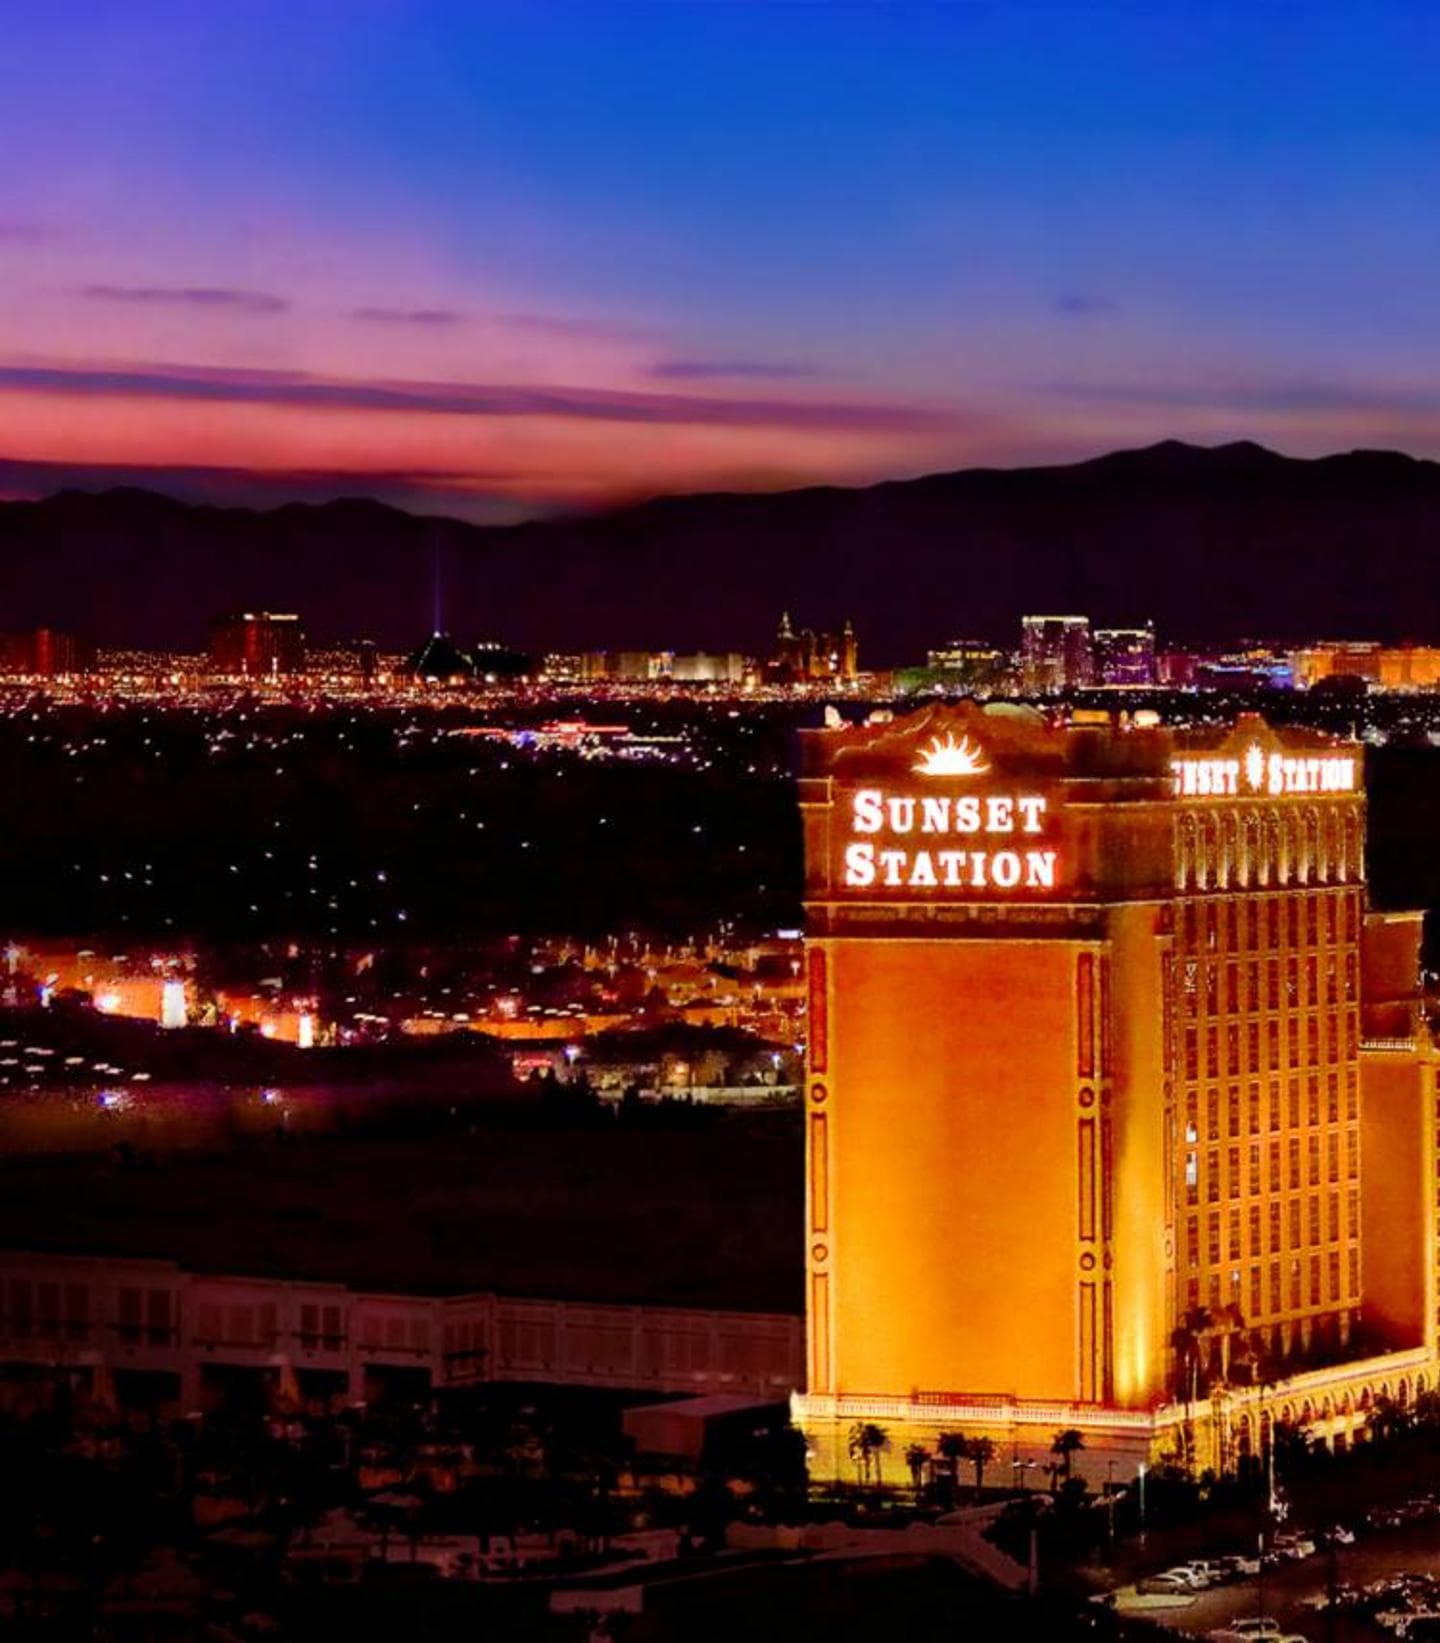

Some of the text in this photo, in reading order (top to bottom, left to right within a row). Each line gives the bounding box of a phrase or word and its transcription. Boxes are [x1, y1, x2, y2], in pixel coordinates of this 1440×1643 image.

[1267, 753, 1355, 795] STATION
[853, 789, 1046, 833] SUNSET
[845, 842, 1056, 887] STATION
